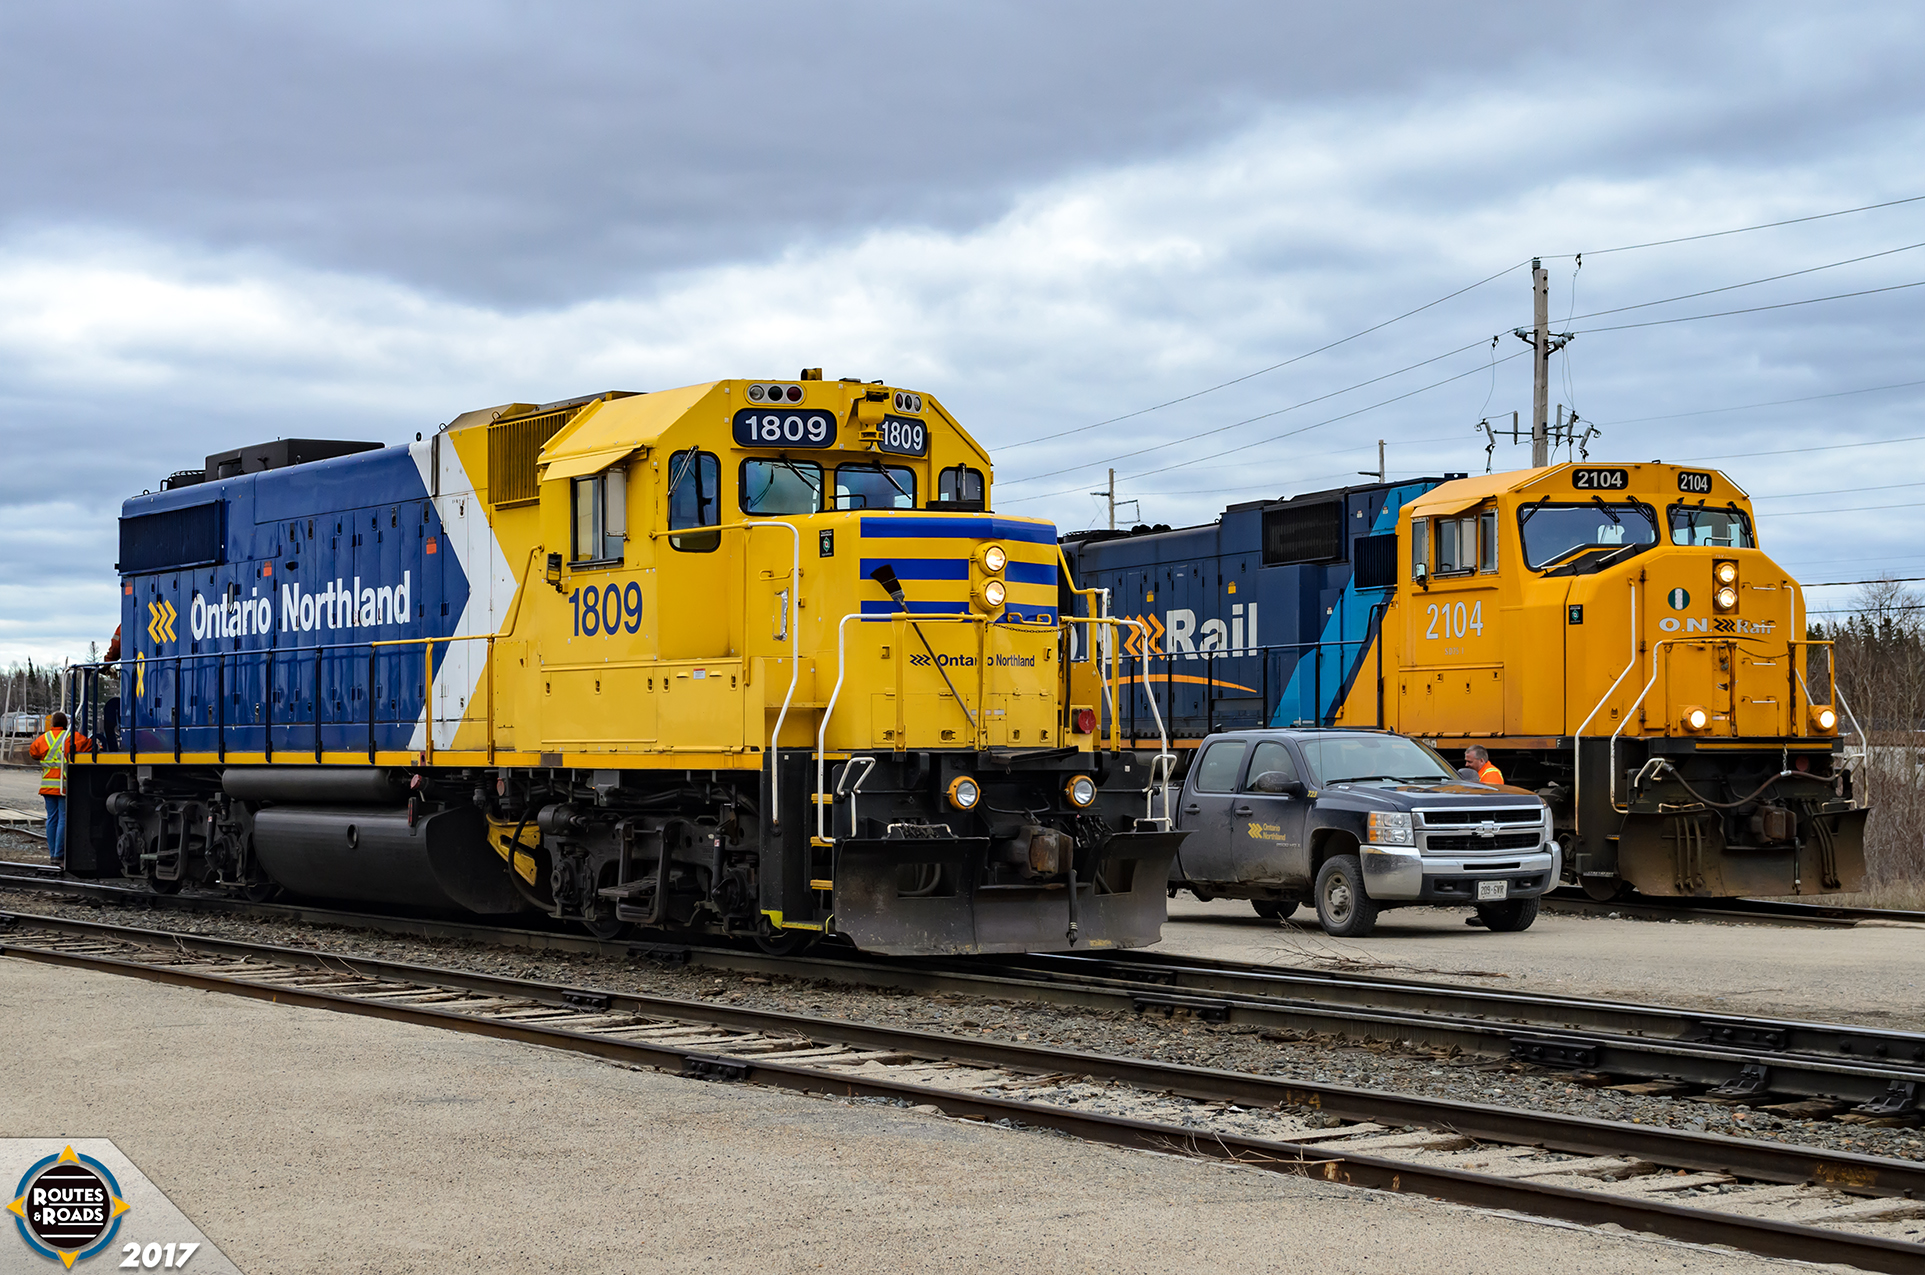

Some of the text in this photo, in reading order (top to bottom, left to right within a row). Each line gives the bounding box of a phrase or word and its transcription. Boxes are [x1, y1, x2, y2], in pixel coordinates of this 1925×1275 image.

[745, 415, 827, 442] 1809
[881, 420, 923, 451] 1809
[1577, 471, 1622, 488] 2104
[1680, 474, 1708, 491] 2104
[190, 570, 411, 641] Ontario Northland
[568, 581, 643, 637] 1809
[1426, 600, 1484, 639] 2104
[1658, 617, 1713, 632] O.N.
[1166, 602, 1258, 661] Rail
[936, 653, 1035, 667] Ontaro Northland
[1262, 822, 1281, 832] Ontario
[1262, 831, 1287, 841] Northland
